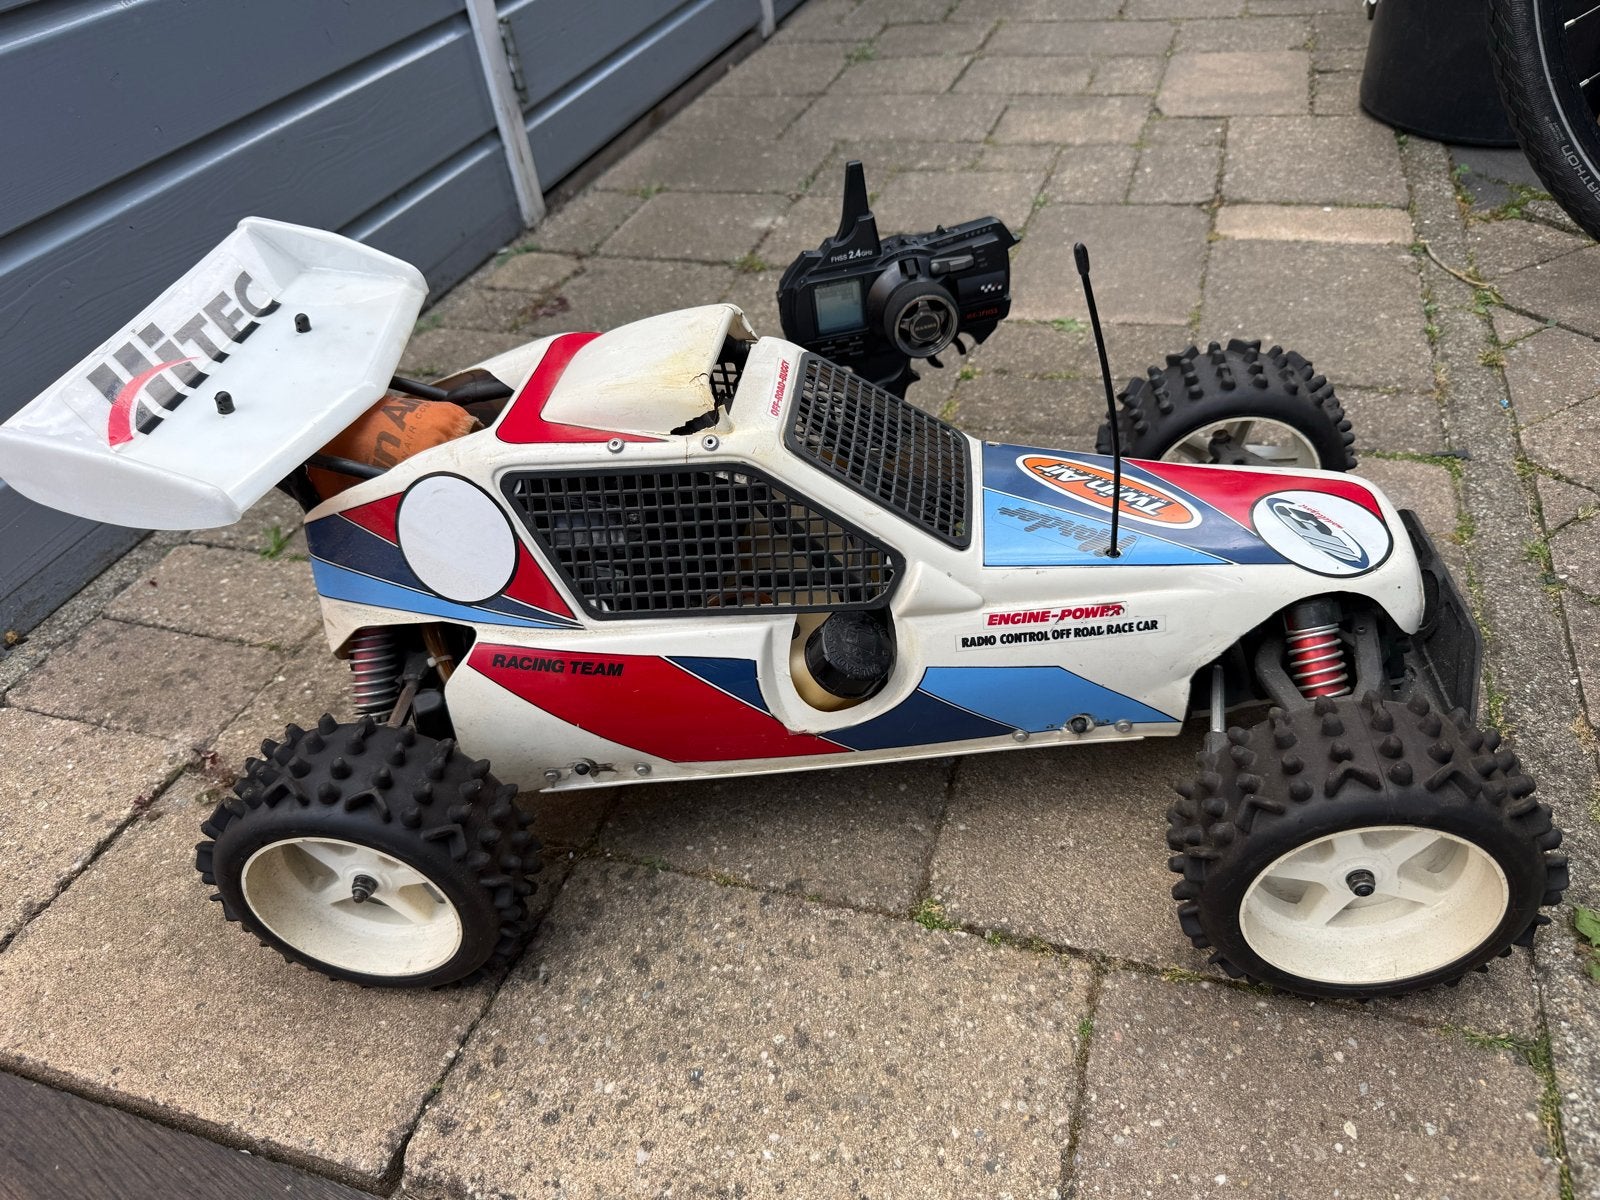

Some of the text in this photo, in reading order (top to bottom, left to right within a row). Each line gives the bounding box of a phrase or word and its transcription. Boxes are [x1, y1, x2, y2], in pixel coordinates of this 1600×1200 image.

[961, 619, 1158, 648] RADIO CONTROL OFF ROAD RACE CAR
[492, 653, 624, 677] RACING TEAM
